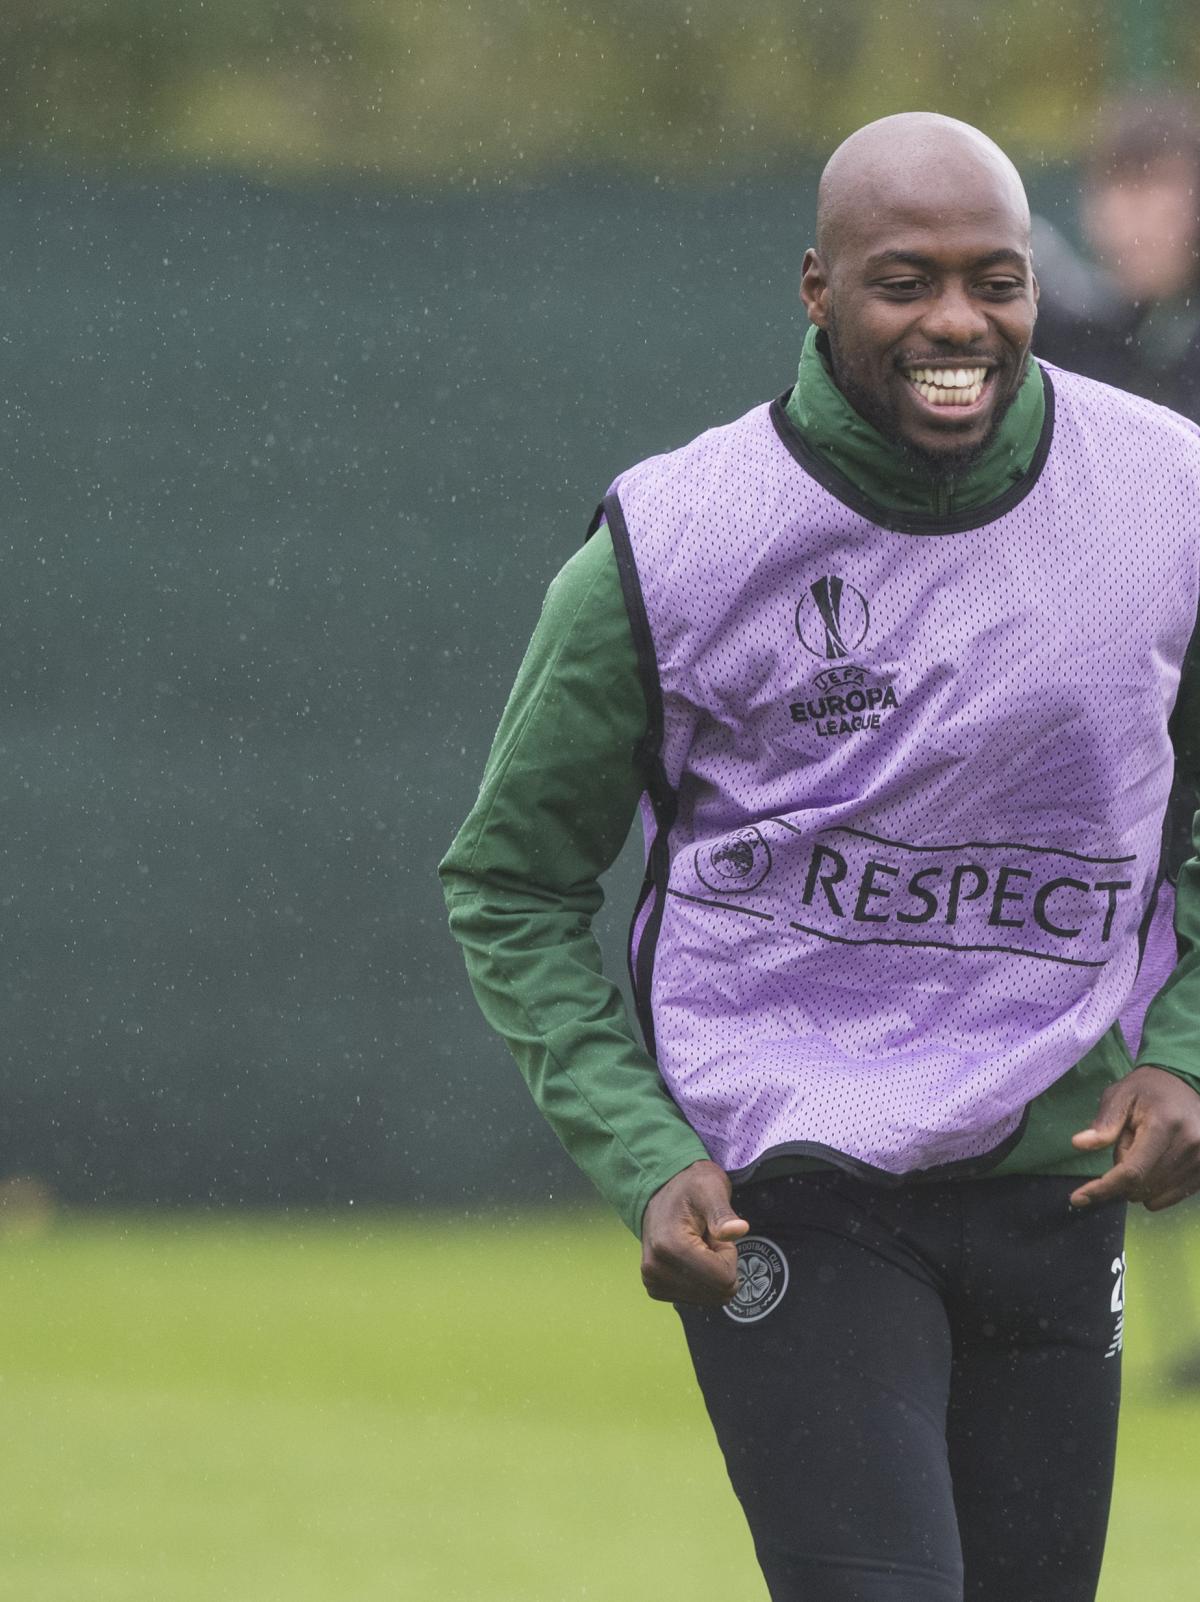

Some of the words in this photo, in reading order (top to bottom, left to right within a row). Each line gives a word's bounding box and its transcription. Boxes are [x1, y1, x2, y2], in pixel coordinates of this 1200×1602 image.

[815, 669, 864, 691] UEFA
[789, 686, 900, 723] EUROPA
[815, 714, 880, 737] LEAGUE
[801, 845, 1131, 942] RESPECT
